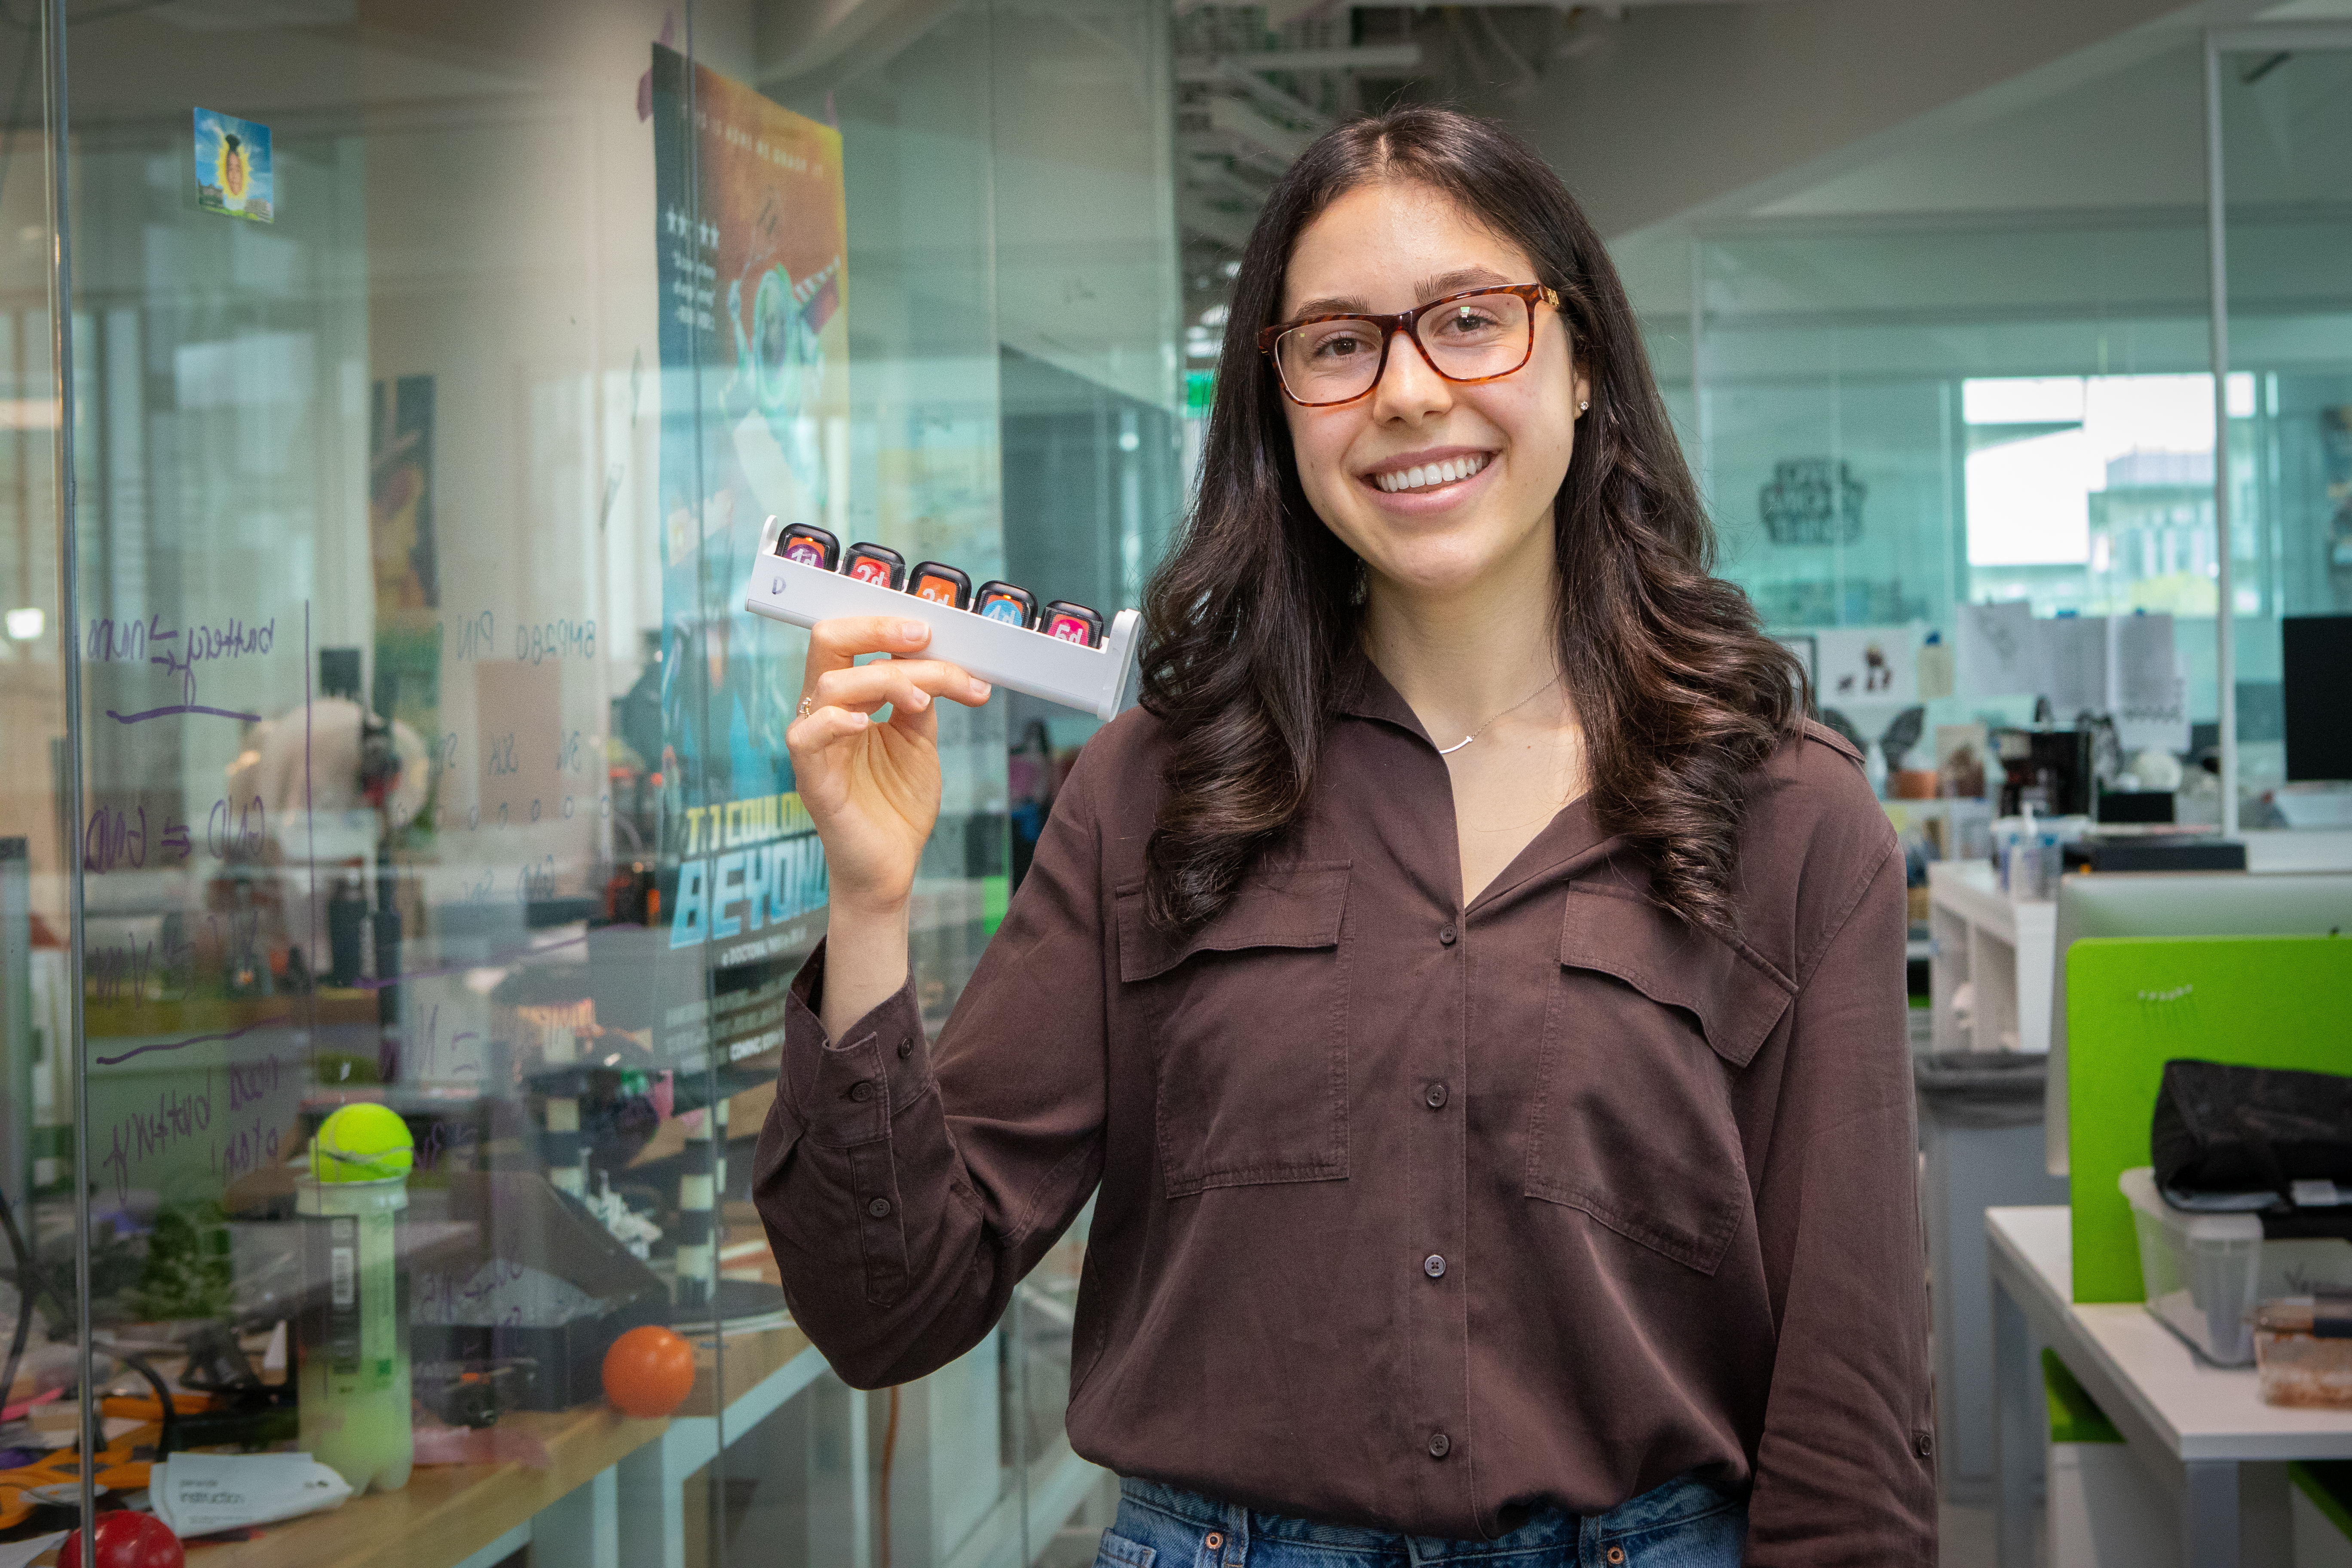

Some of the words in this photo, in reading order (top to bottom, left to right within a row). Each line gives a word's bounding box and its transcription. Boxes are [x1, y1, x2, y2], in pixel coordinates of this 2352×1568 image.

[792, 548, 817, 566] 1d
[772, 576, 787, 594] D
[857, 565, 885, 586] 2d
[1055, 624, 1083, 644] 5d
